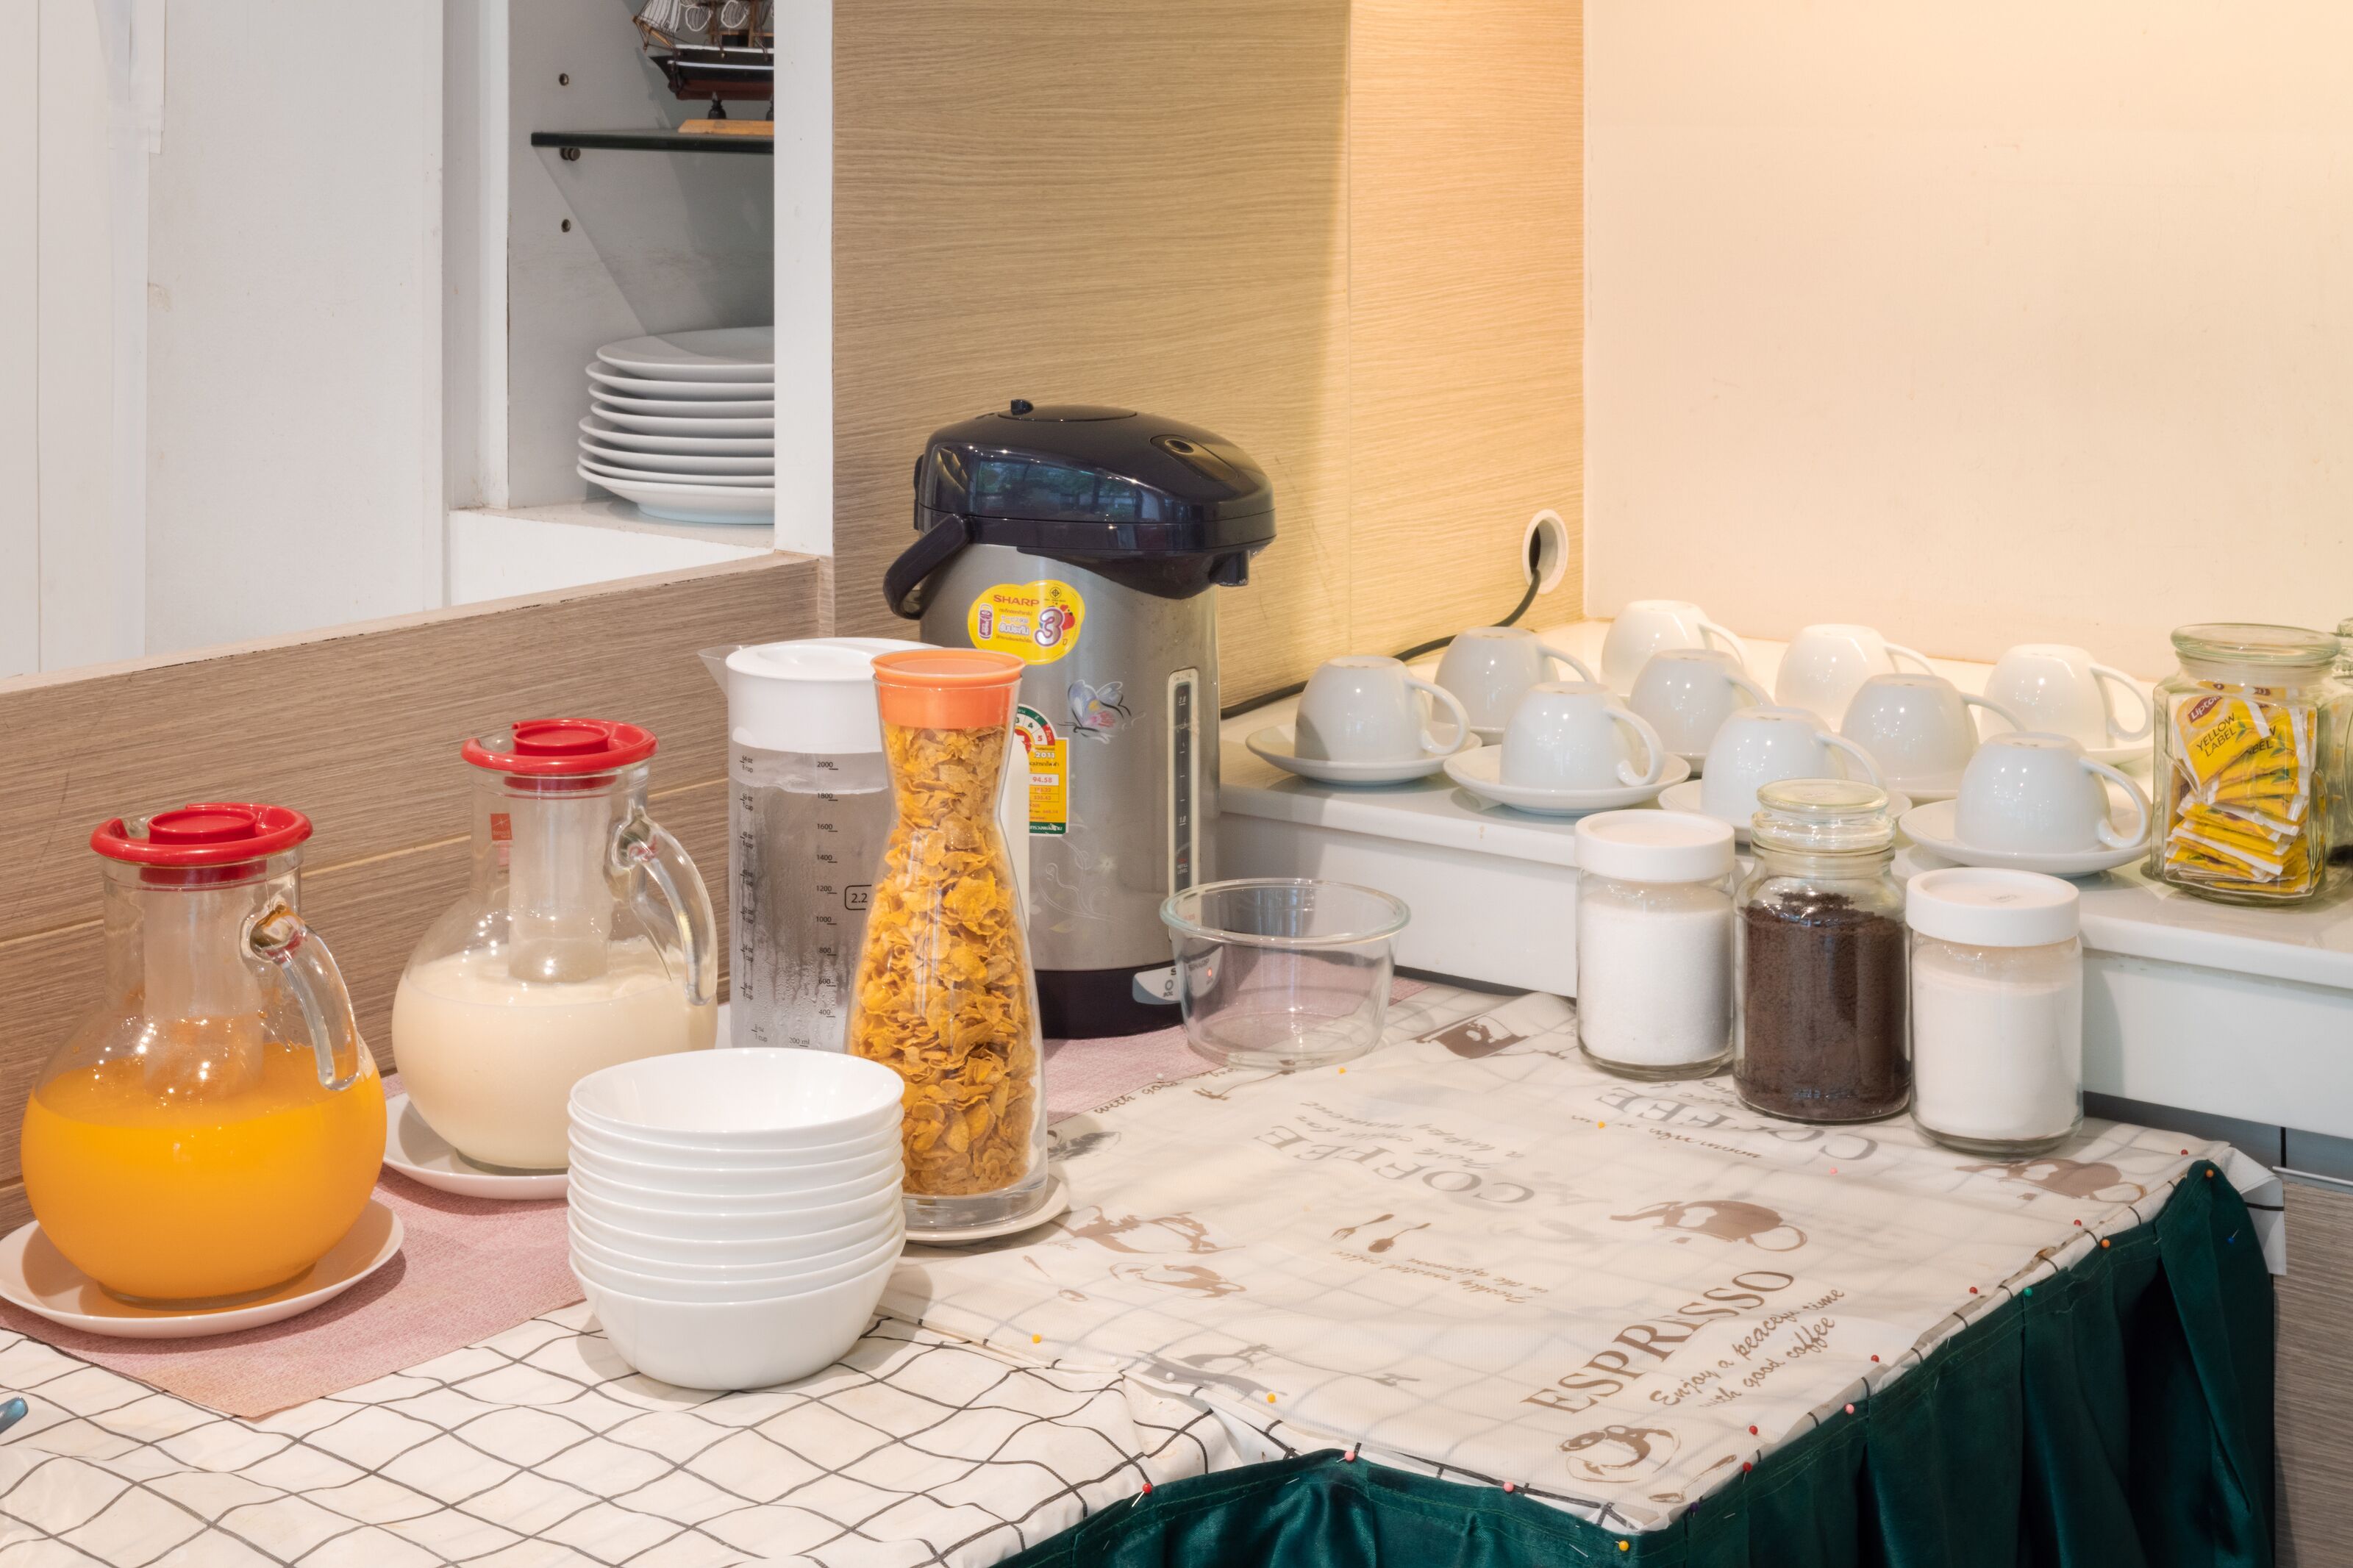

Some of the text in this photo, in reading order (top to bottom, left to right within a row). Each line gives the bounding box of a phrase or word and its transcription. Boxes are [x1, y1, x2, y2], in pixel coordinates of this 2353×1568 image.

[993, 594, 1040, 607] SHARP
[1035, 608, 1063, 647] 3
[2196, 712, 2235, 751] YELLOW
[2204, 728, 2236, 757] LABEL
[1294, 1114, 1340, 1132] for
[1299, 1100, 1405, 1129] moment
[1411, 1123, 1496, 1151] happy
[1253, 1125, 1535, 1203] COFFEE
[1493, 1276, 1524, 1287] the
[1743, 1358, 1785, 1387] good
[1785, 1317, 1835, 1358] coffee
[1649, 1369, 1721, 1406] Enjoy
[1718, 1359, 1735, 1368] a
